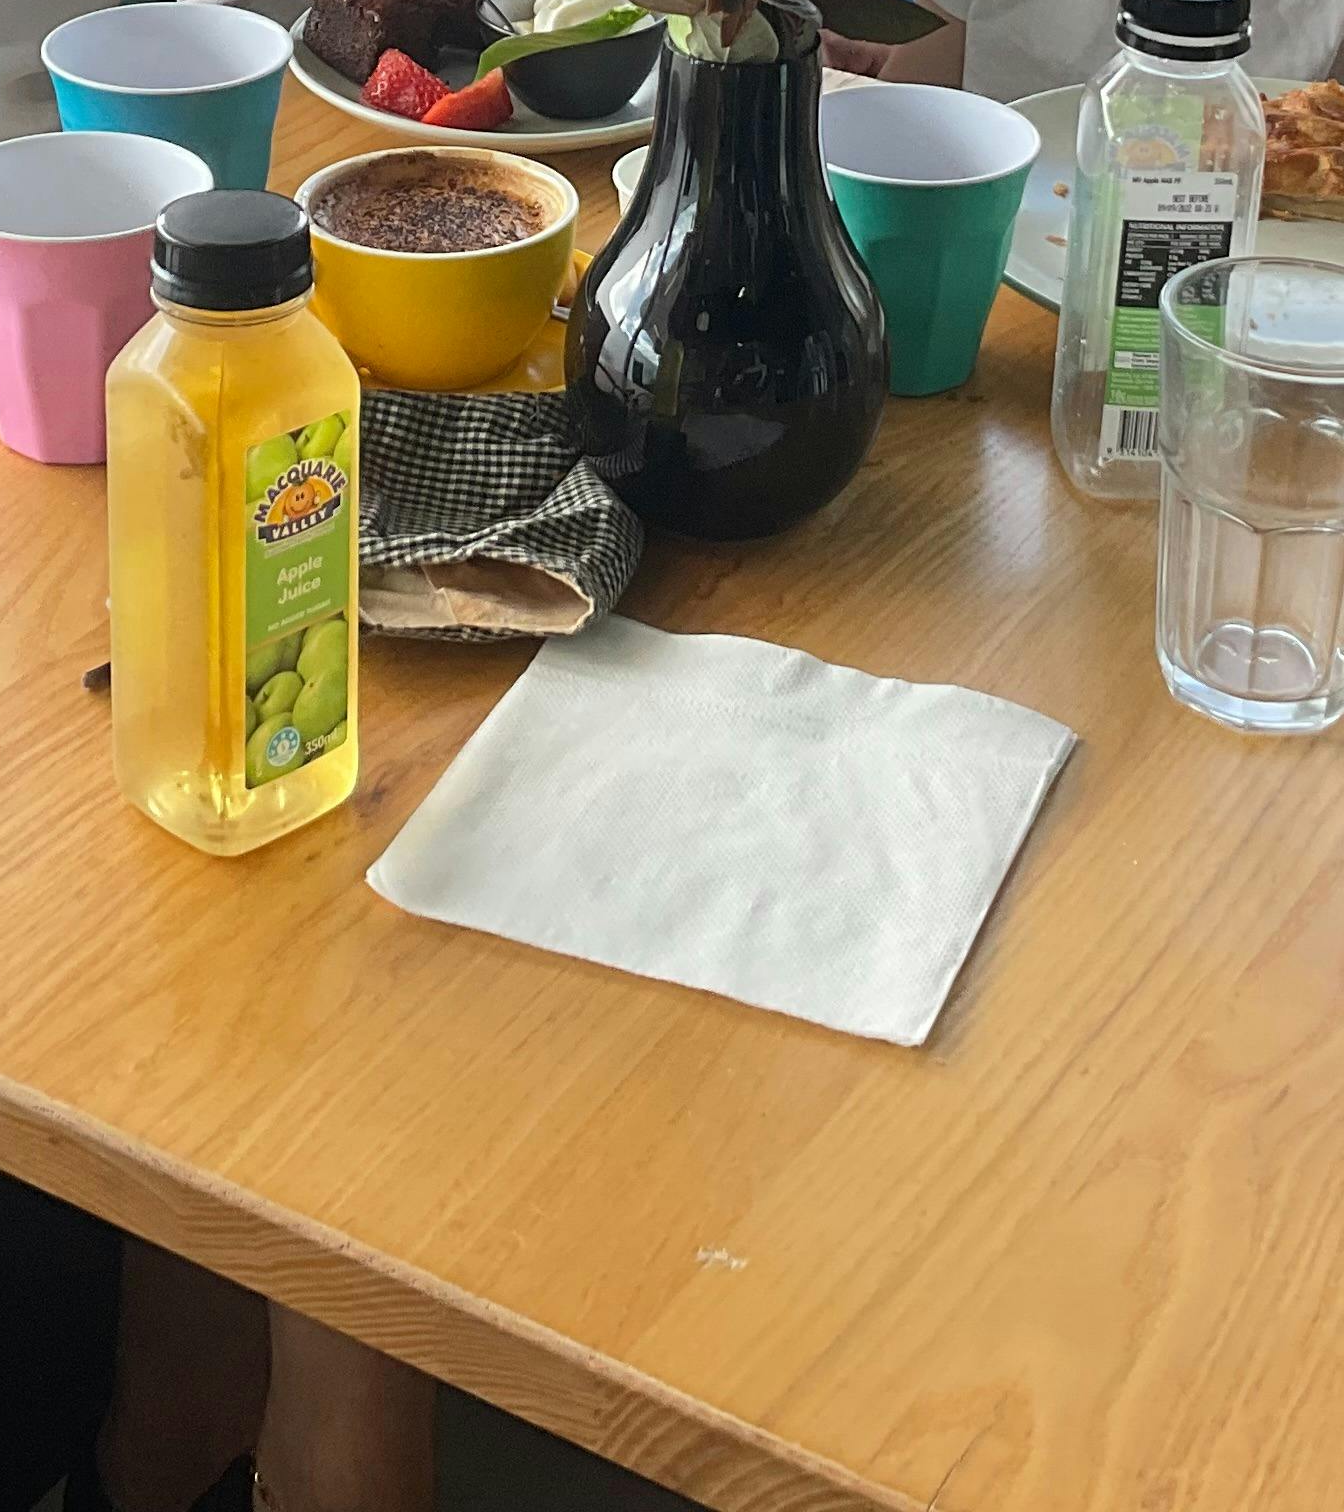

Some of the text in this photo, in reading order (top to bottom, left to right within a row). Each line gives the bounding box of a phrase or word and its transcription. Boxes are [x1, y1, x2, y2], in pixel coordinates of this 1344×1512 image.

[254, 461, 347, 522] MACQUARIE
[272, 507, 327, 540] VALLEY
[277, 556, 323, 585] Apple
[278, 577, 322, 604] Juice
